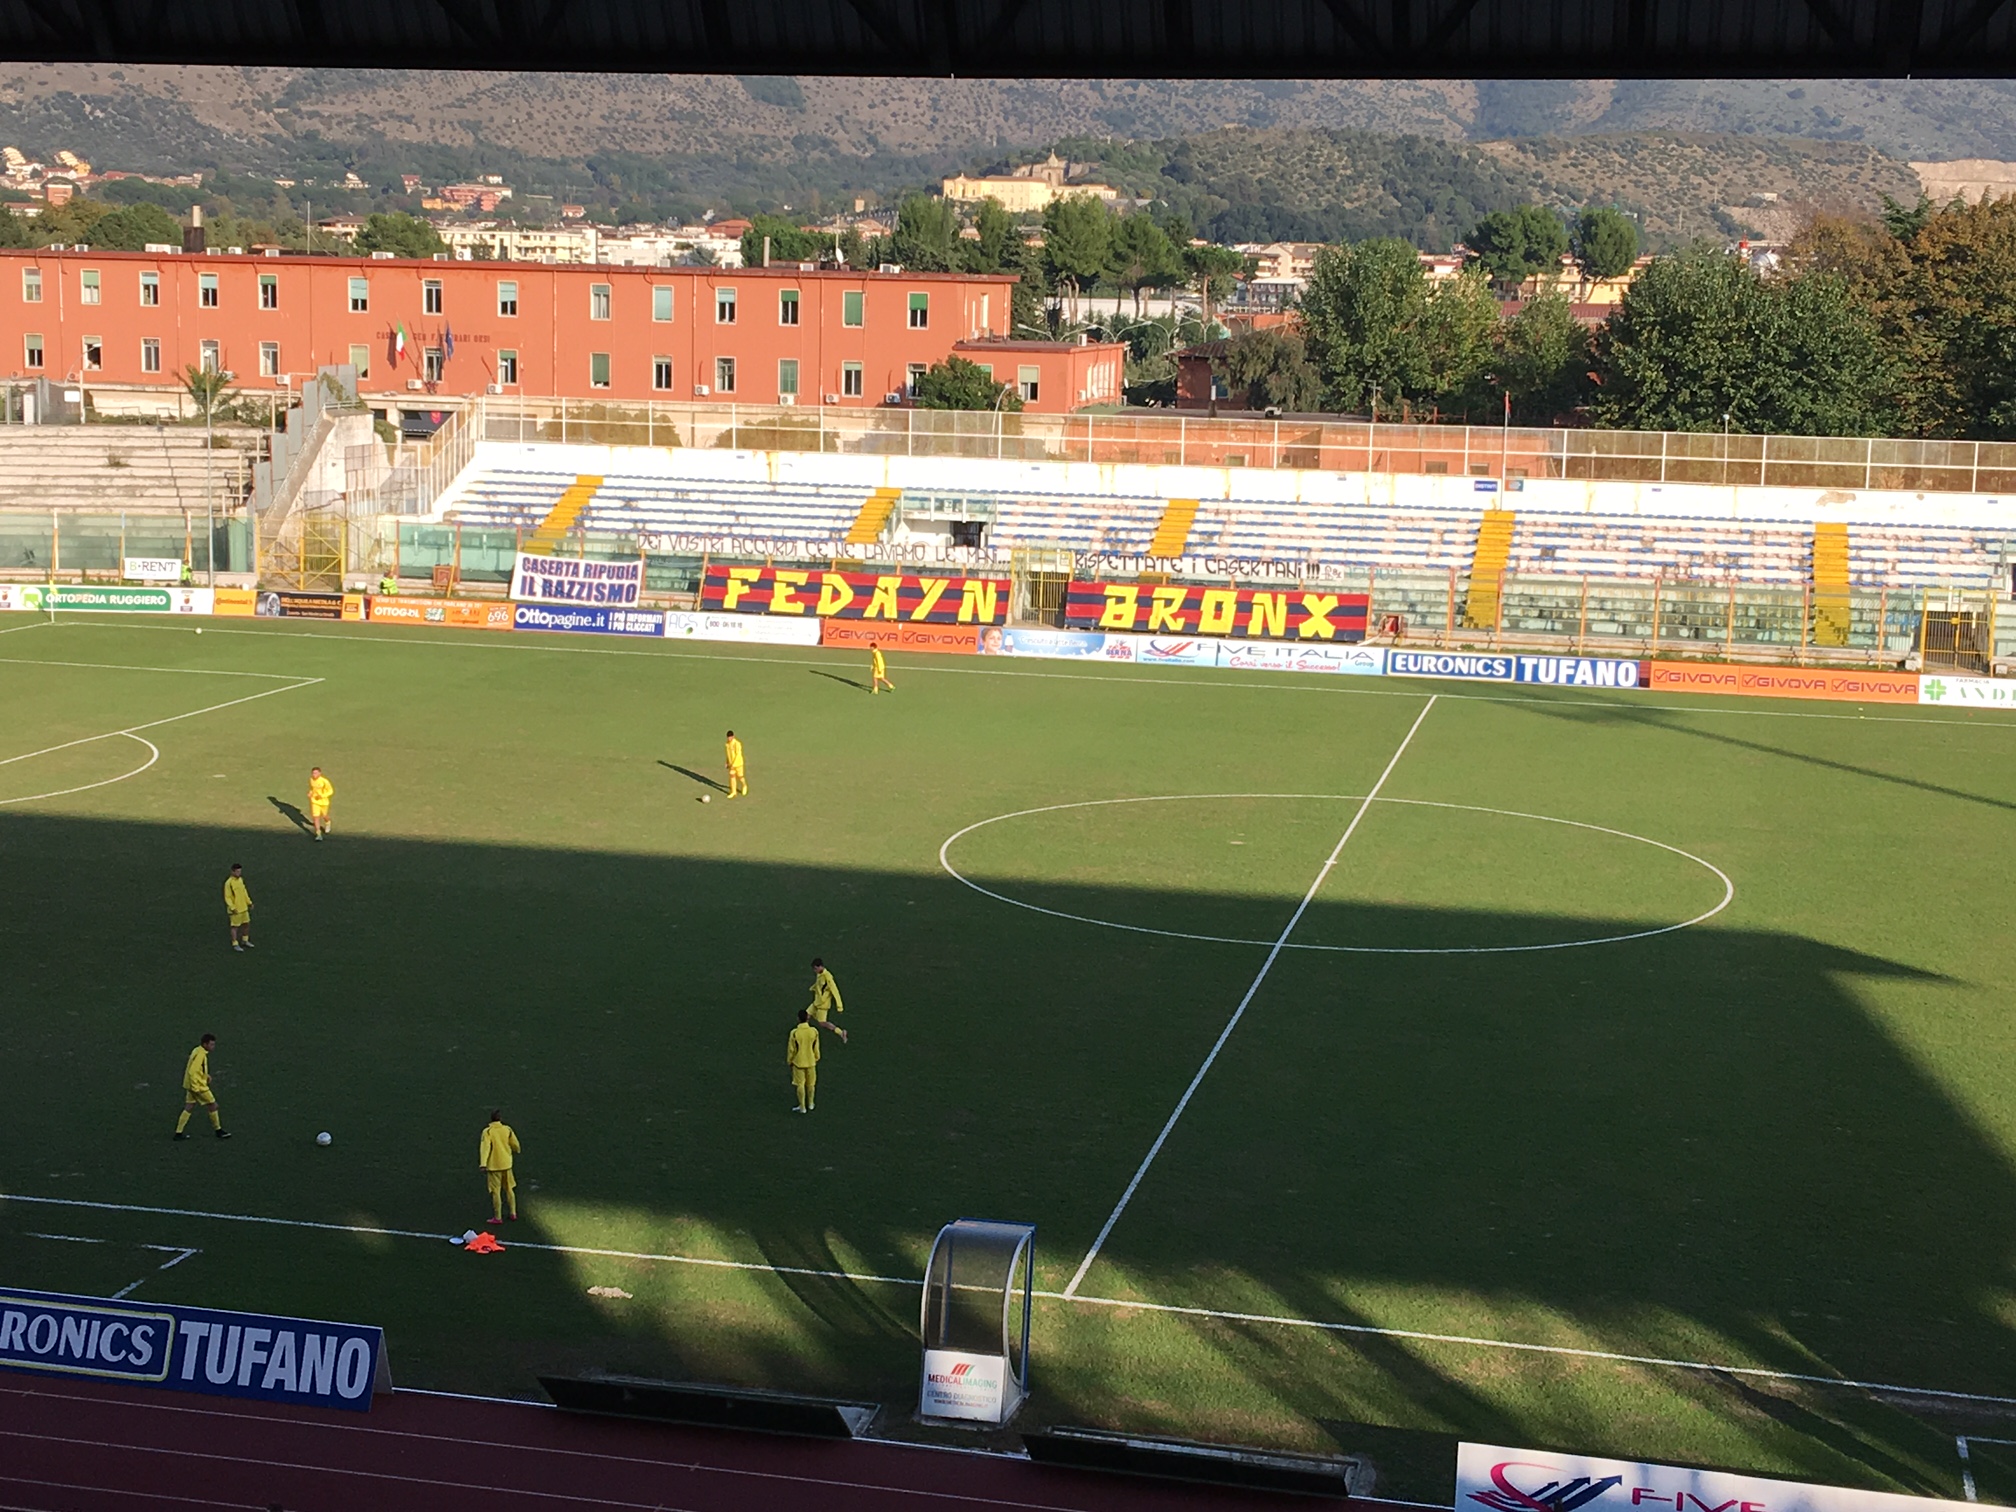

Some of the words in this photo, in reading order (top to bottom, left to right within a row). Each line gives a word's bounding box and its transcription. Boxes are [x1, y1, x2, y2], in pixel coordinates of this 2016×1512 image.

[935, 547, 956, 562] LE
[522, 557, 581, 578] CASERTA
[583, 562, 639, 581] RIPUDIA
[45, 593, 107, 605] ORTOPEDIA
[109, 594, 167, 606] RUGGIERO
[520, 575, 537, 597] IL
[541, 577, 638, 603] RAZZISMO
[722, 567, 997, 623] FEDAYN
[487, 611, 509, 622] 696
[515, 607, 606, 629] Ottopagine.it
[1099, 584, 1339, 639] BRONX
[838, 629, 898, 642] GIVOVA
[915, 633, 976, 646] GIVOVA
[1275, 647, 1375, 662] ITALIA
[1394, 653, 1507, 677] EURONICS
[1520, 657, 1637, 687] TUFANO
[1667, 672, 1737, 686] GIVOVA
[1755, 676, 1827, 690] GIVOVA
[1846, 680, 1918, 695] GIVOVA
[179, 1319, 371, 1400] TUFANO
[927, 1390, 952, 1398] CENTRO
